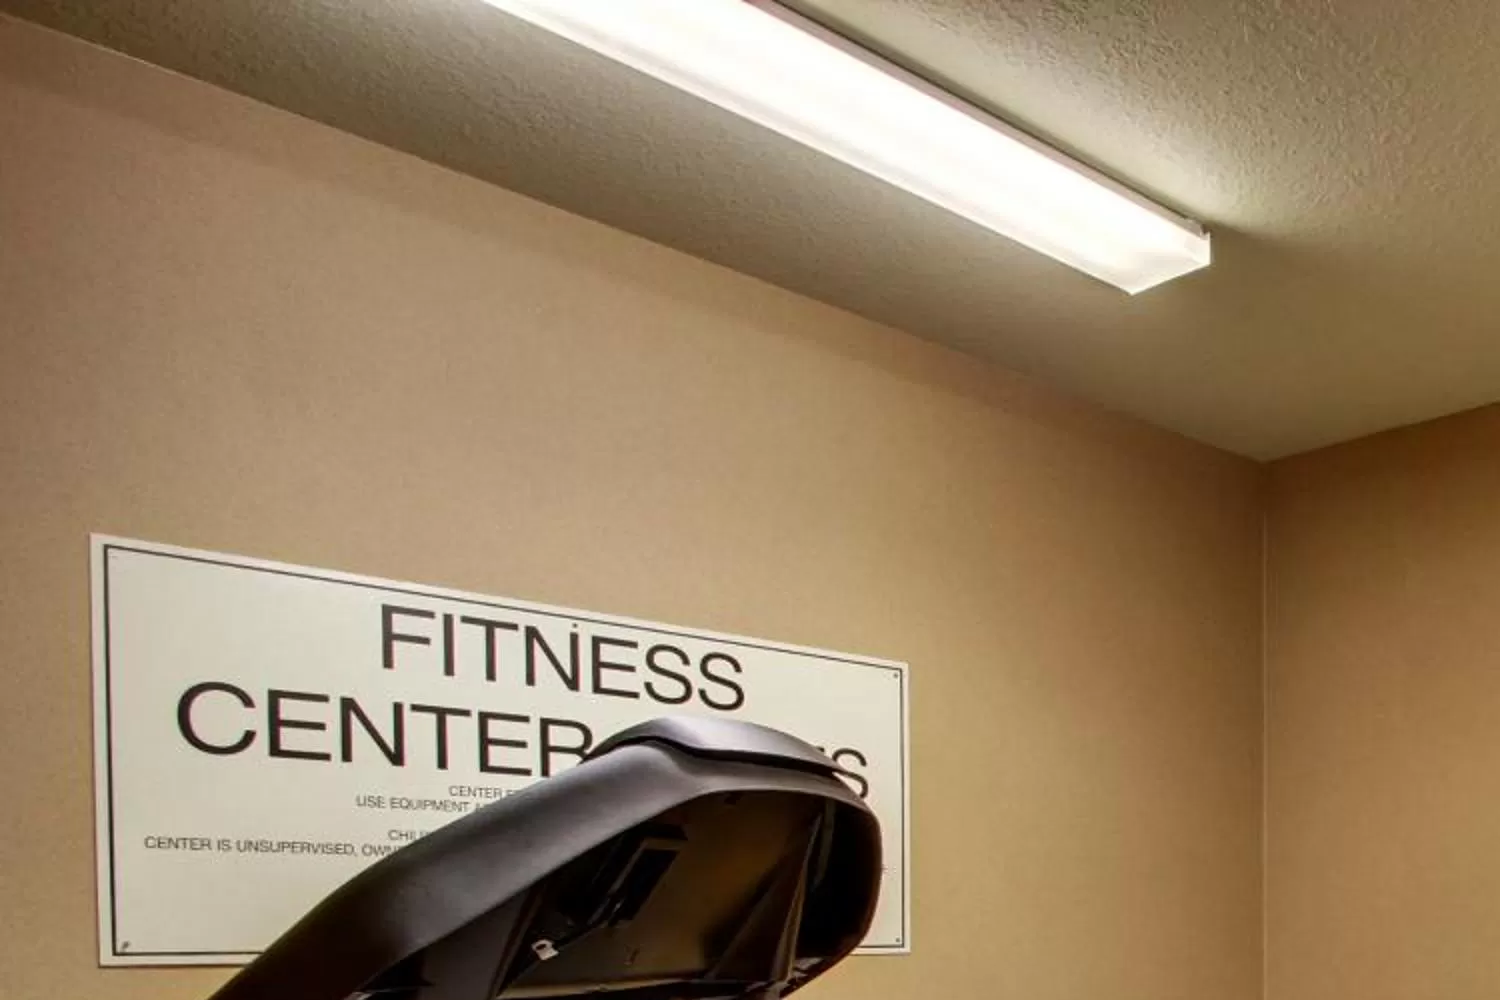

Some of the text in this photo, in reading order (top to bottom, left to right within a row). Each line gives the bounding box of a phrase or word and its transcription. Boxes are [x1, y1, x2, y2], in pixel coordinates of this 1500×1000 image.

[380, 603, 745, 712] FITNESS
[175, 680, 594, 779] CENTER
[448, 785, 502, 799] CENTER
[356, 795, 386, 809] USE
[389, 797, 470, 813] EQUIPMENT
[144, 835, 212, 851] CENTER
[216, 839, 232, 852] IS
